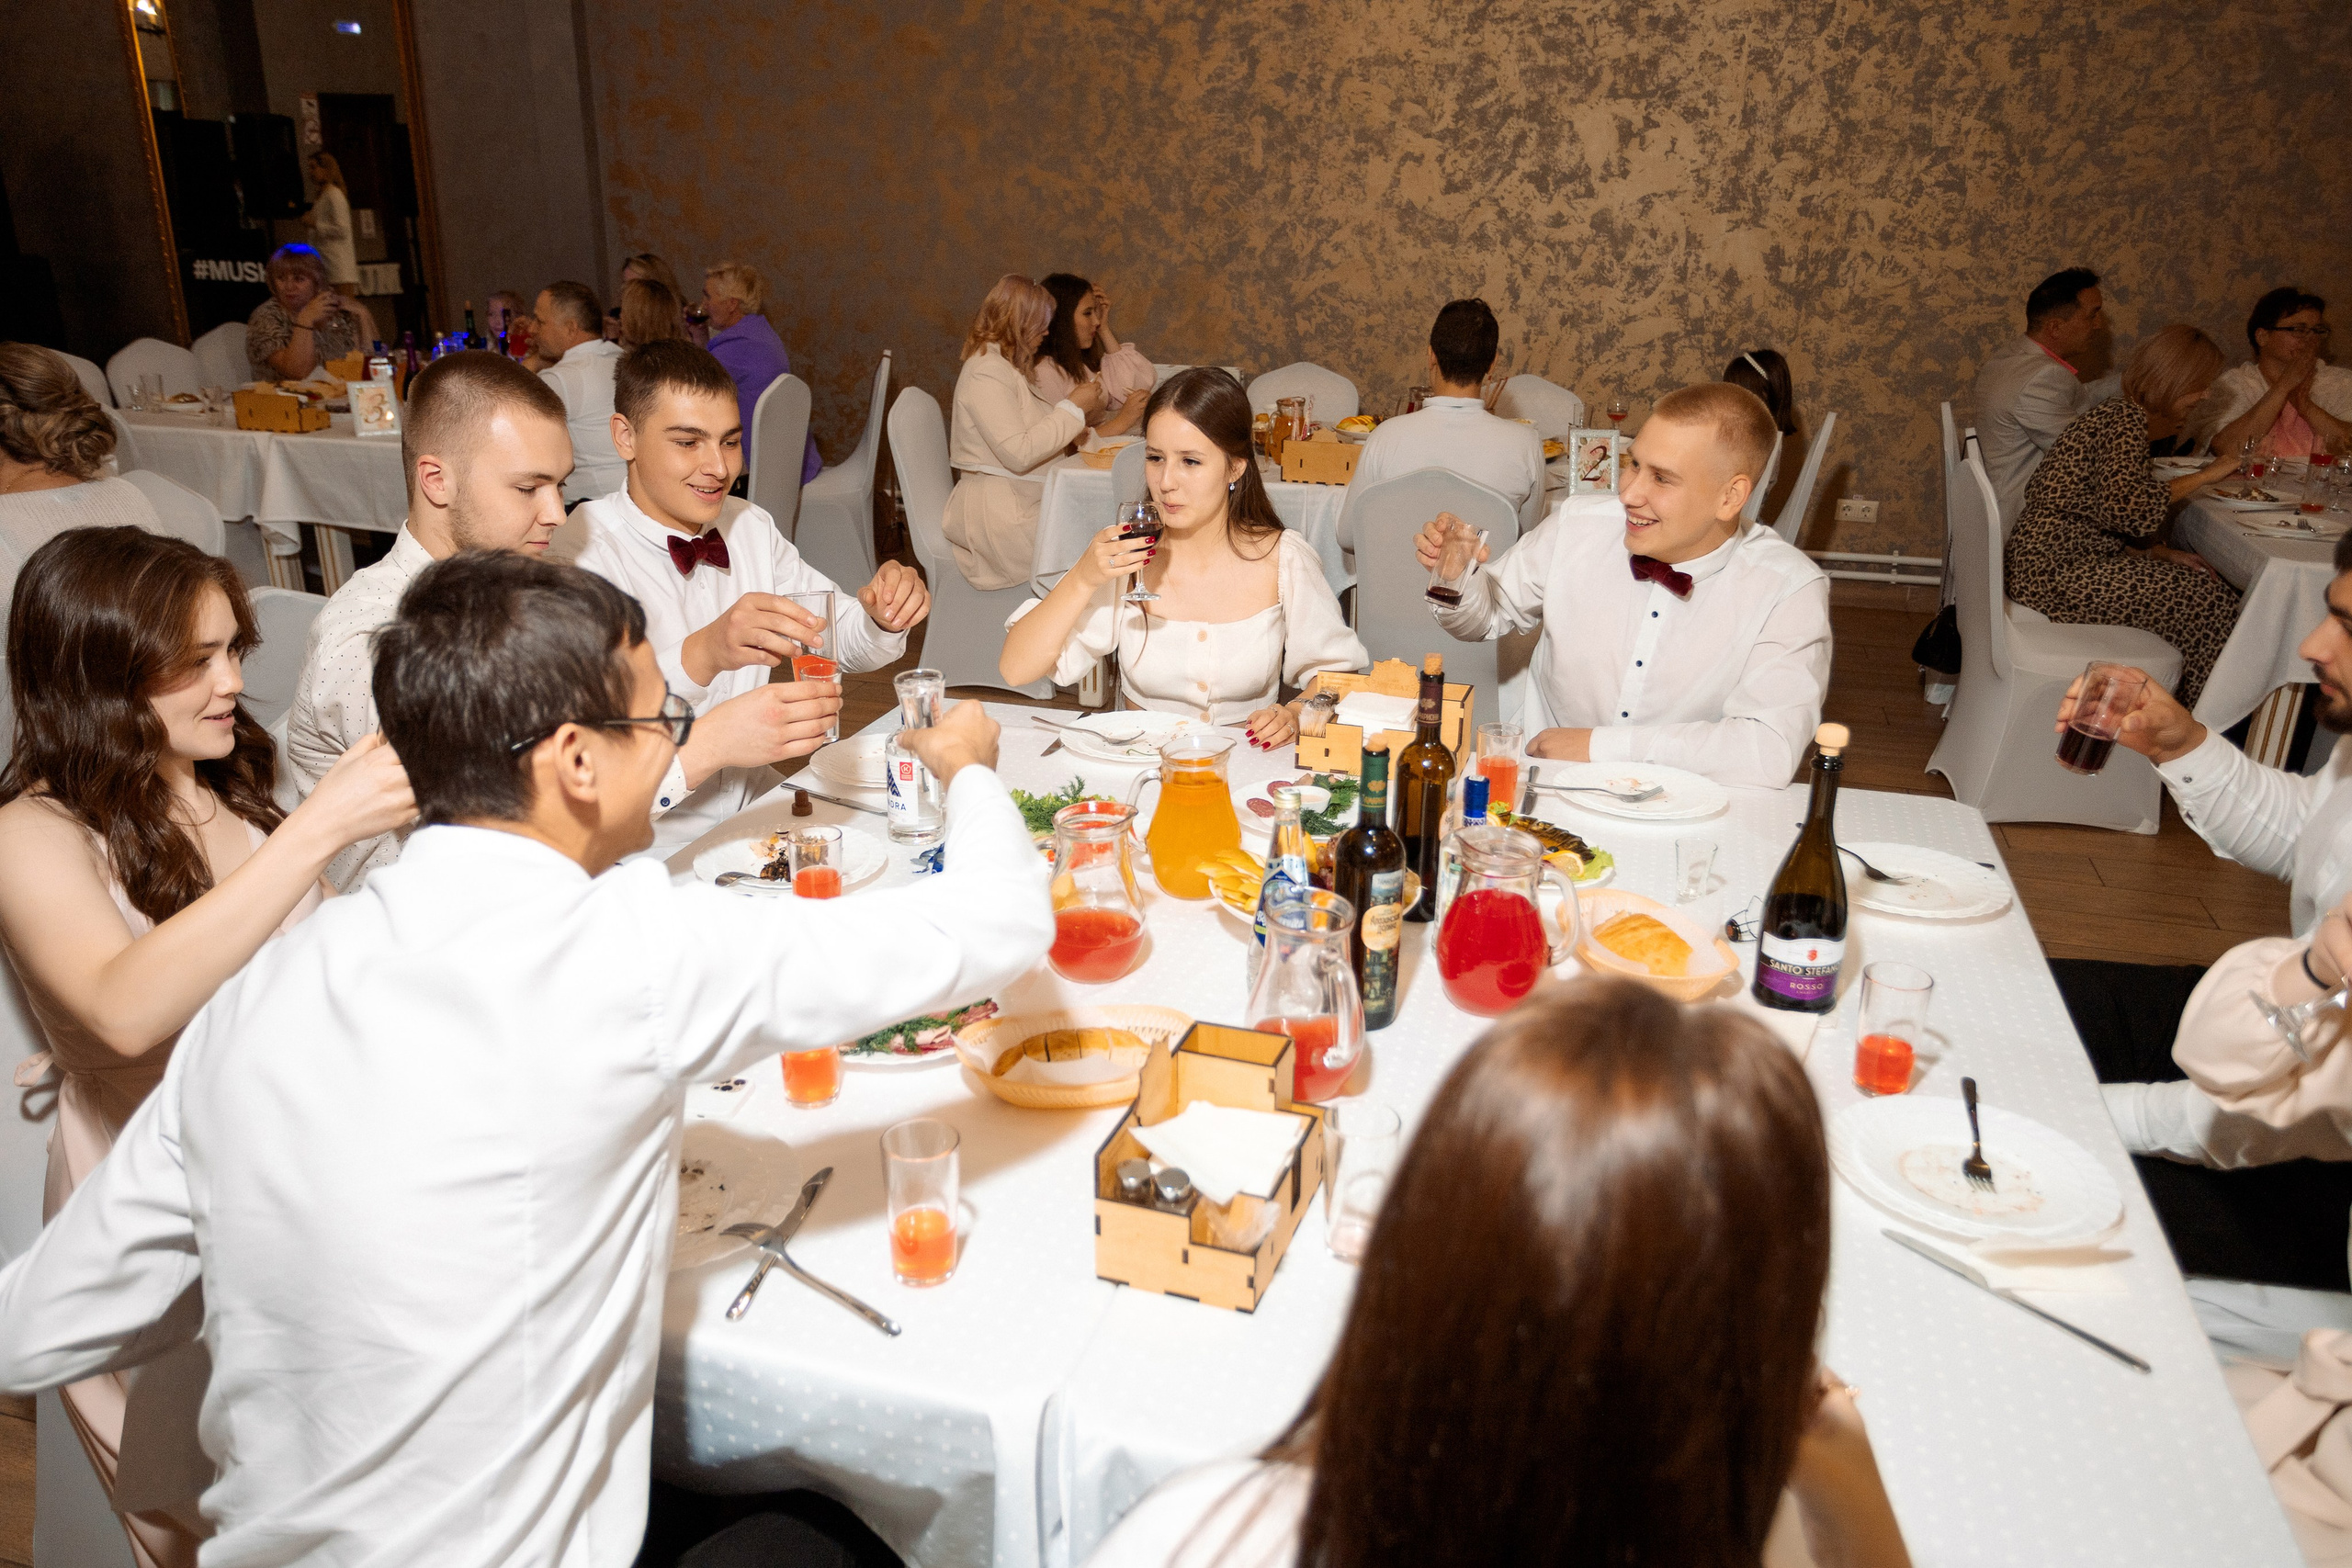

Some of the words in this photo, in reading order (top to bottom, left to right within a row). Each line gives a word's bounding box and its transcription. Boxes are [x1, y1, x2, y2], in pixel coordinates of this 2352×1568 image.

[364, 393, 388, 423] 3
[1581, 445, 1608, 482] 2
[1770, 959, 1802, 975] SANTO
[1790, 982, 1824, 990] ROSSO
